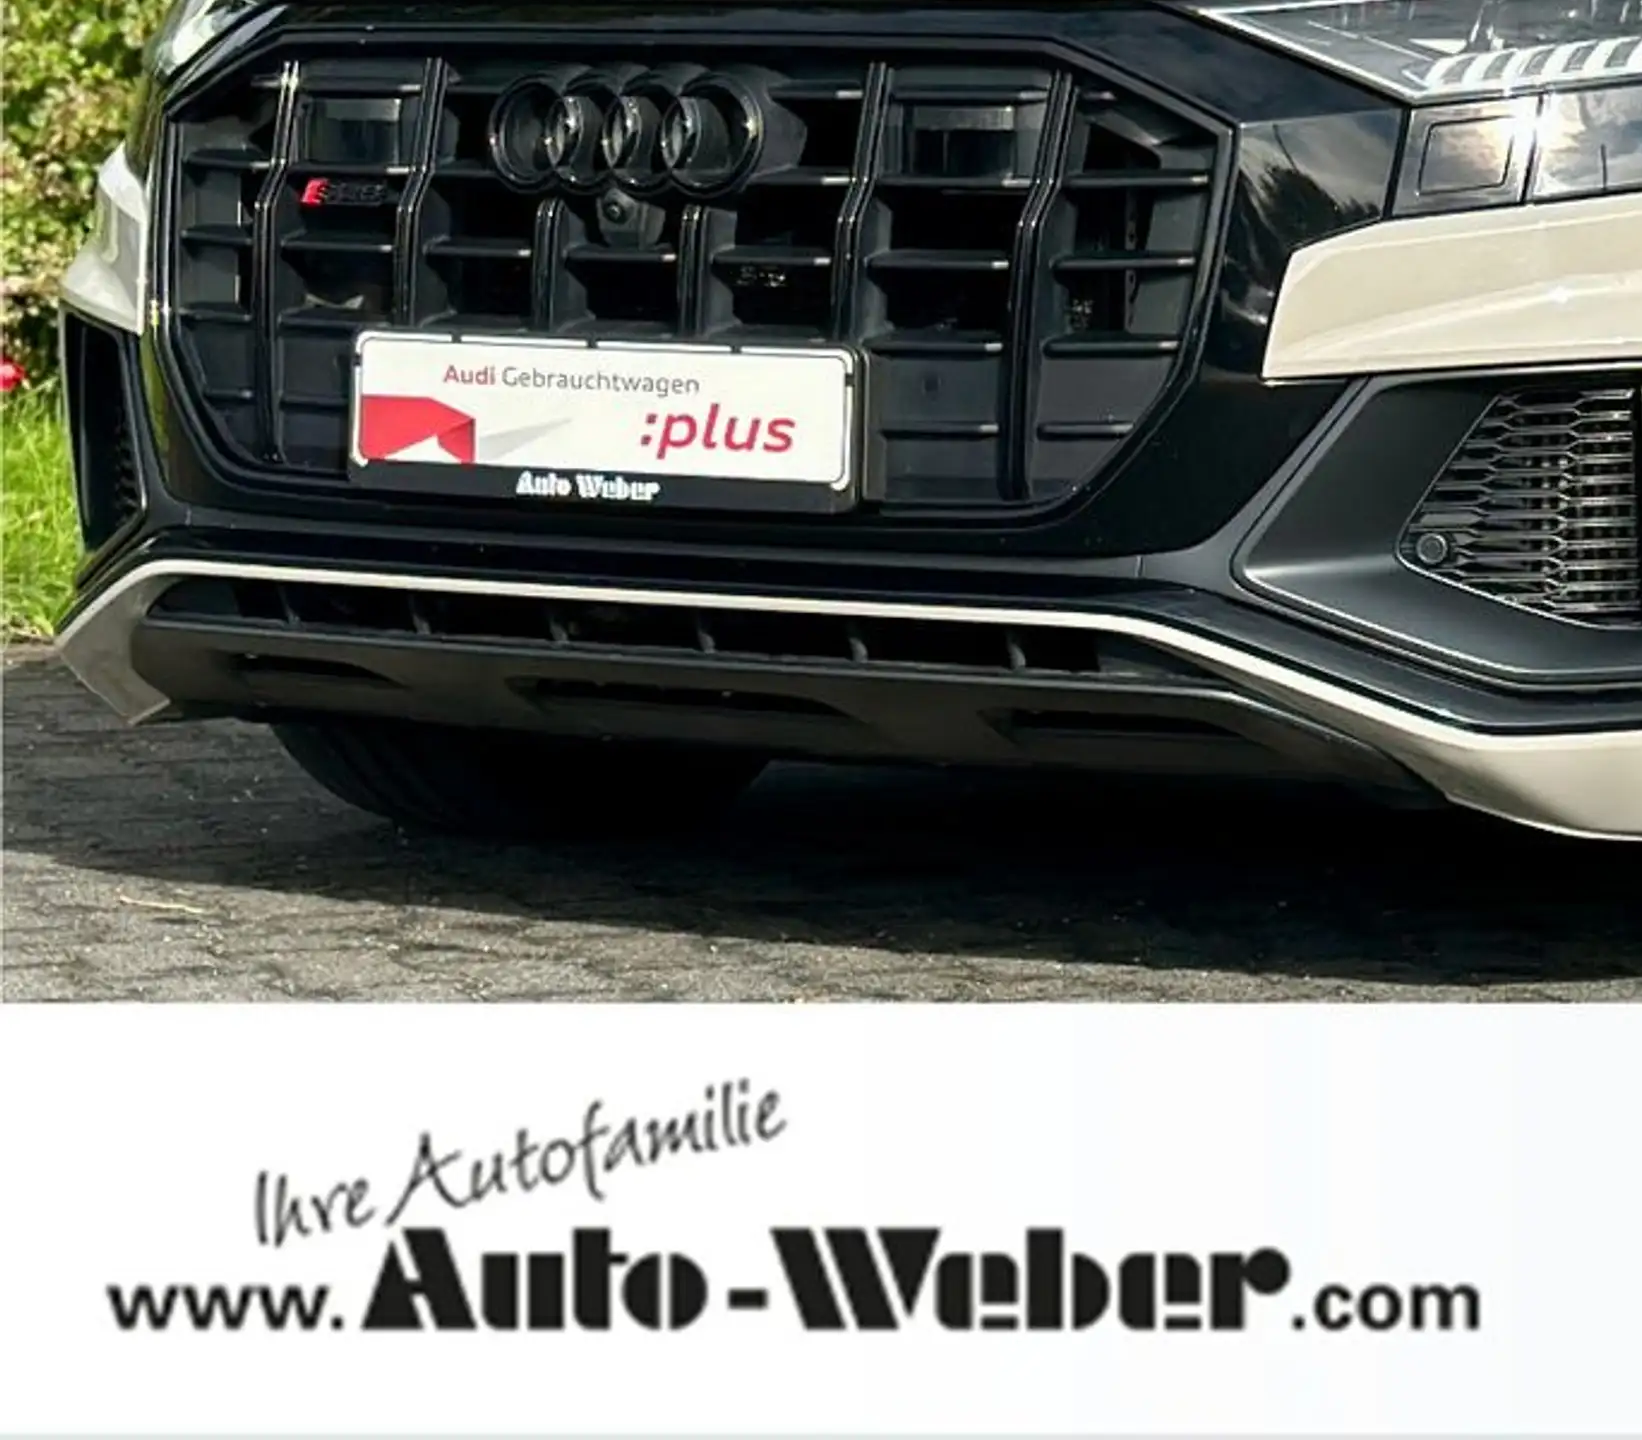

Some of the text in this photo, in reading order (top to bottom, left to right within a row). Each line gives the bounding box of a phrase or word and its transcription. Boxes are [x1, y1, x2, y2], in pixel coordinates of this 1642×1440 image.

[443, 364, 701, 397] Audi Gebrauchtwagen
[639, 402, 797, 460] :plus
[515, 469, 662, 501] Auto Weber
